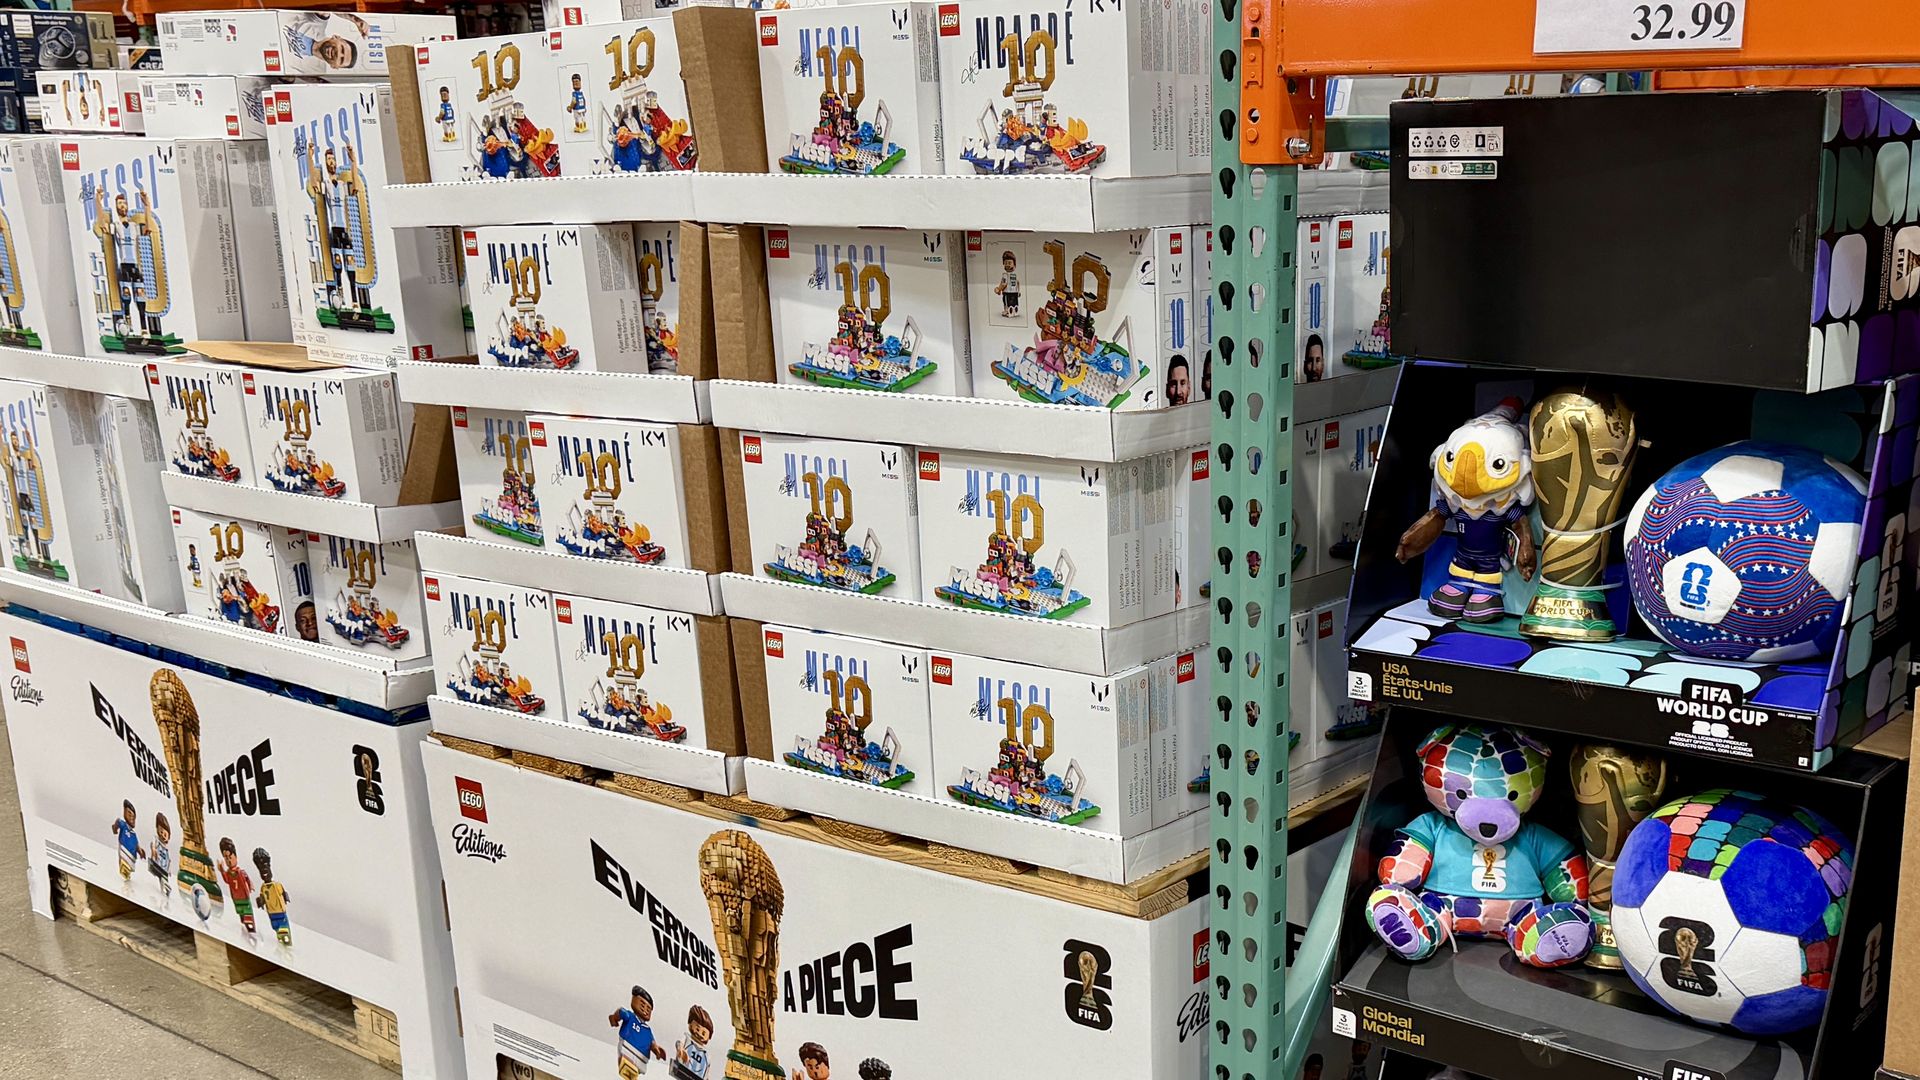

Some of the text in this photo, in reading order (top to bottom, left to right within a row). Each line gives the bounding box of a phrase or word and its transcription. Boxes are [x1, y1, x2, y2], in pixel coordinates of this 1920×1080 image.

[762, 25, 776, 37] LEGO
[940, 15, 957, 27] LEGO
[1630, 1, 1736, 42] 32.99
[368, 25, 384, 64] MESSI
[1000, 29, 1057, 97] 10
[816, 45, 865, 109] 10
[277, 101, 290, 113] LEGO
[63, 152, 78, 161] LEGO
[293, 103, 365, 191] MESSI
[80, 155, 159, 231] MESSI
[557, 230, 578, 246] KM
[770, 239, 787, 249] LEGO
[1896, 248, 1905, 281] FIFA
[505, 256, 542, 307] 10
[834, 261, 892, 324] 10
[225, 296, 233, 313] Lionel
[1170, 298, 1184, 349] 10
[217, 371, 233, 386] KM
[325, 380, 343, 395] KM
[531, 430, 545, 440] LEGO
[642, 430, 666, 447] KM
[745, 445, 760, 455] LEGO
[578, 451, 623, 500] 10
[921, 461, 938, 472] LEGO
[1193, 459, 1208, 472] LEGO
[802, 471, 854, 532] 10
[986, 489, 1045, 555] 10
[293, 562, 311, 597] 10
[526, 592, 548, 609] KM
[1554, 599, 1574, 607] FIFA
[557, 606, 572, 617] LEGO
[468, 608, 507, 653] 10
[667, 615, 691, 633] KM
[767, 639, 782, 650] LEGO
[14, 649, 28, 663] LEGO
[604, 632, 646, 680] 10
[933, 664, 951, 677] LEGO
[1178, 662, 1194, 675] LEGO
[1382, 662, 1410, 676] USA
[10, 675, 44, 706] Editions
[1356, 676, 1363, 686] 3
[1382, 673, 1454, 694] États-Unis
[823, 669, 874, 732] 10
[1382, 685, 1424, 701] EE. UU.
[1691, 684, 1733, 705] FIFA
[1656, 697, 1727, 721] WORLD
[1728, 707, 1769, 727] CUP
[89, 681, 169, 779] EVERYONE
[998, 697, 1055, 763] 10
[1674, 731, 1749, 747] OFFICIAL LICENSED PRODUCT
[1692, 720, 1730, 739] 26
[130, 749, 172, 800] WANTS
[206, 738, 281, 816] A PIECE
[366, 799, 379, 810] FIFA
[460, 789, 482, 810] LEGO
[452, 823, 507, 864] Editions
[589, 837, 717, 972] EVERYONE
[651, 925, 719, 991] WANTS
[1194, 941, 1210, 968] LE
[783, 923, 919, 1021] A PIECE
[1677, 978, 1704, 991] FIFA
[1078, 1007, 1100, 1023] FIFA
[1340, 1013, 1348, 1023] 3
[1363, 1005, 1413, 1029] Global
[1362, 1020, 1425, 1046] Mondial
[515, 1062, 532, 1078] WG
